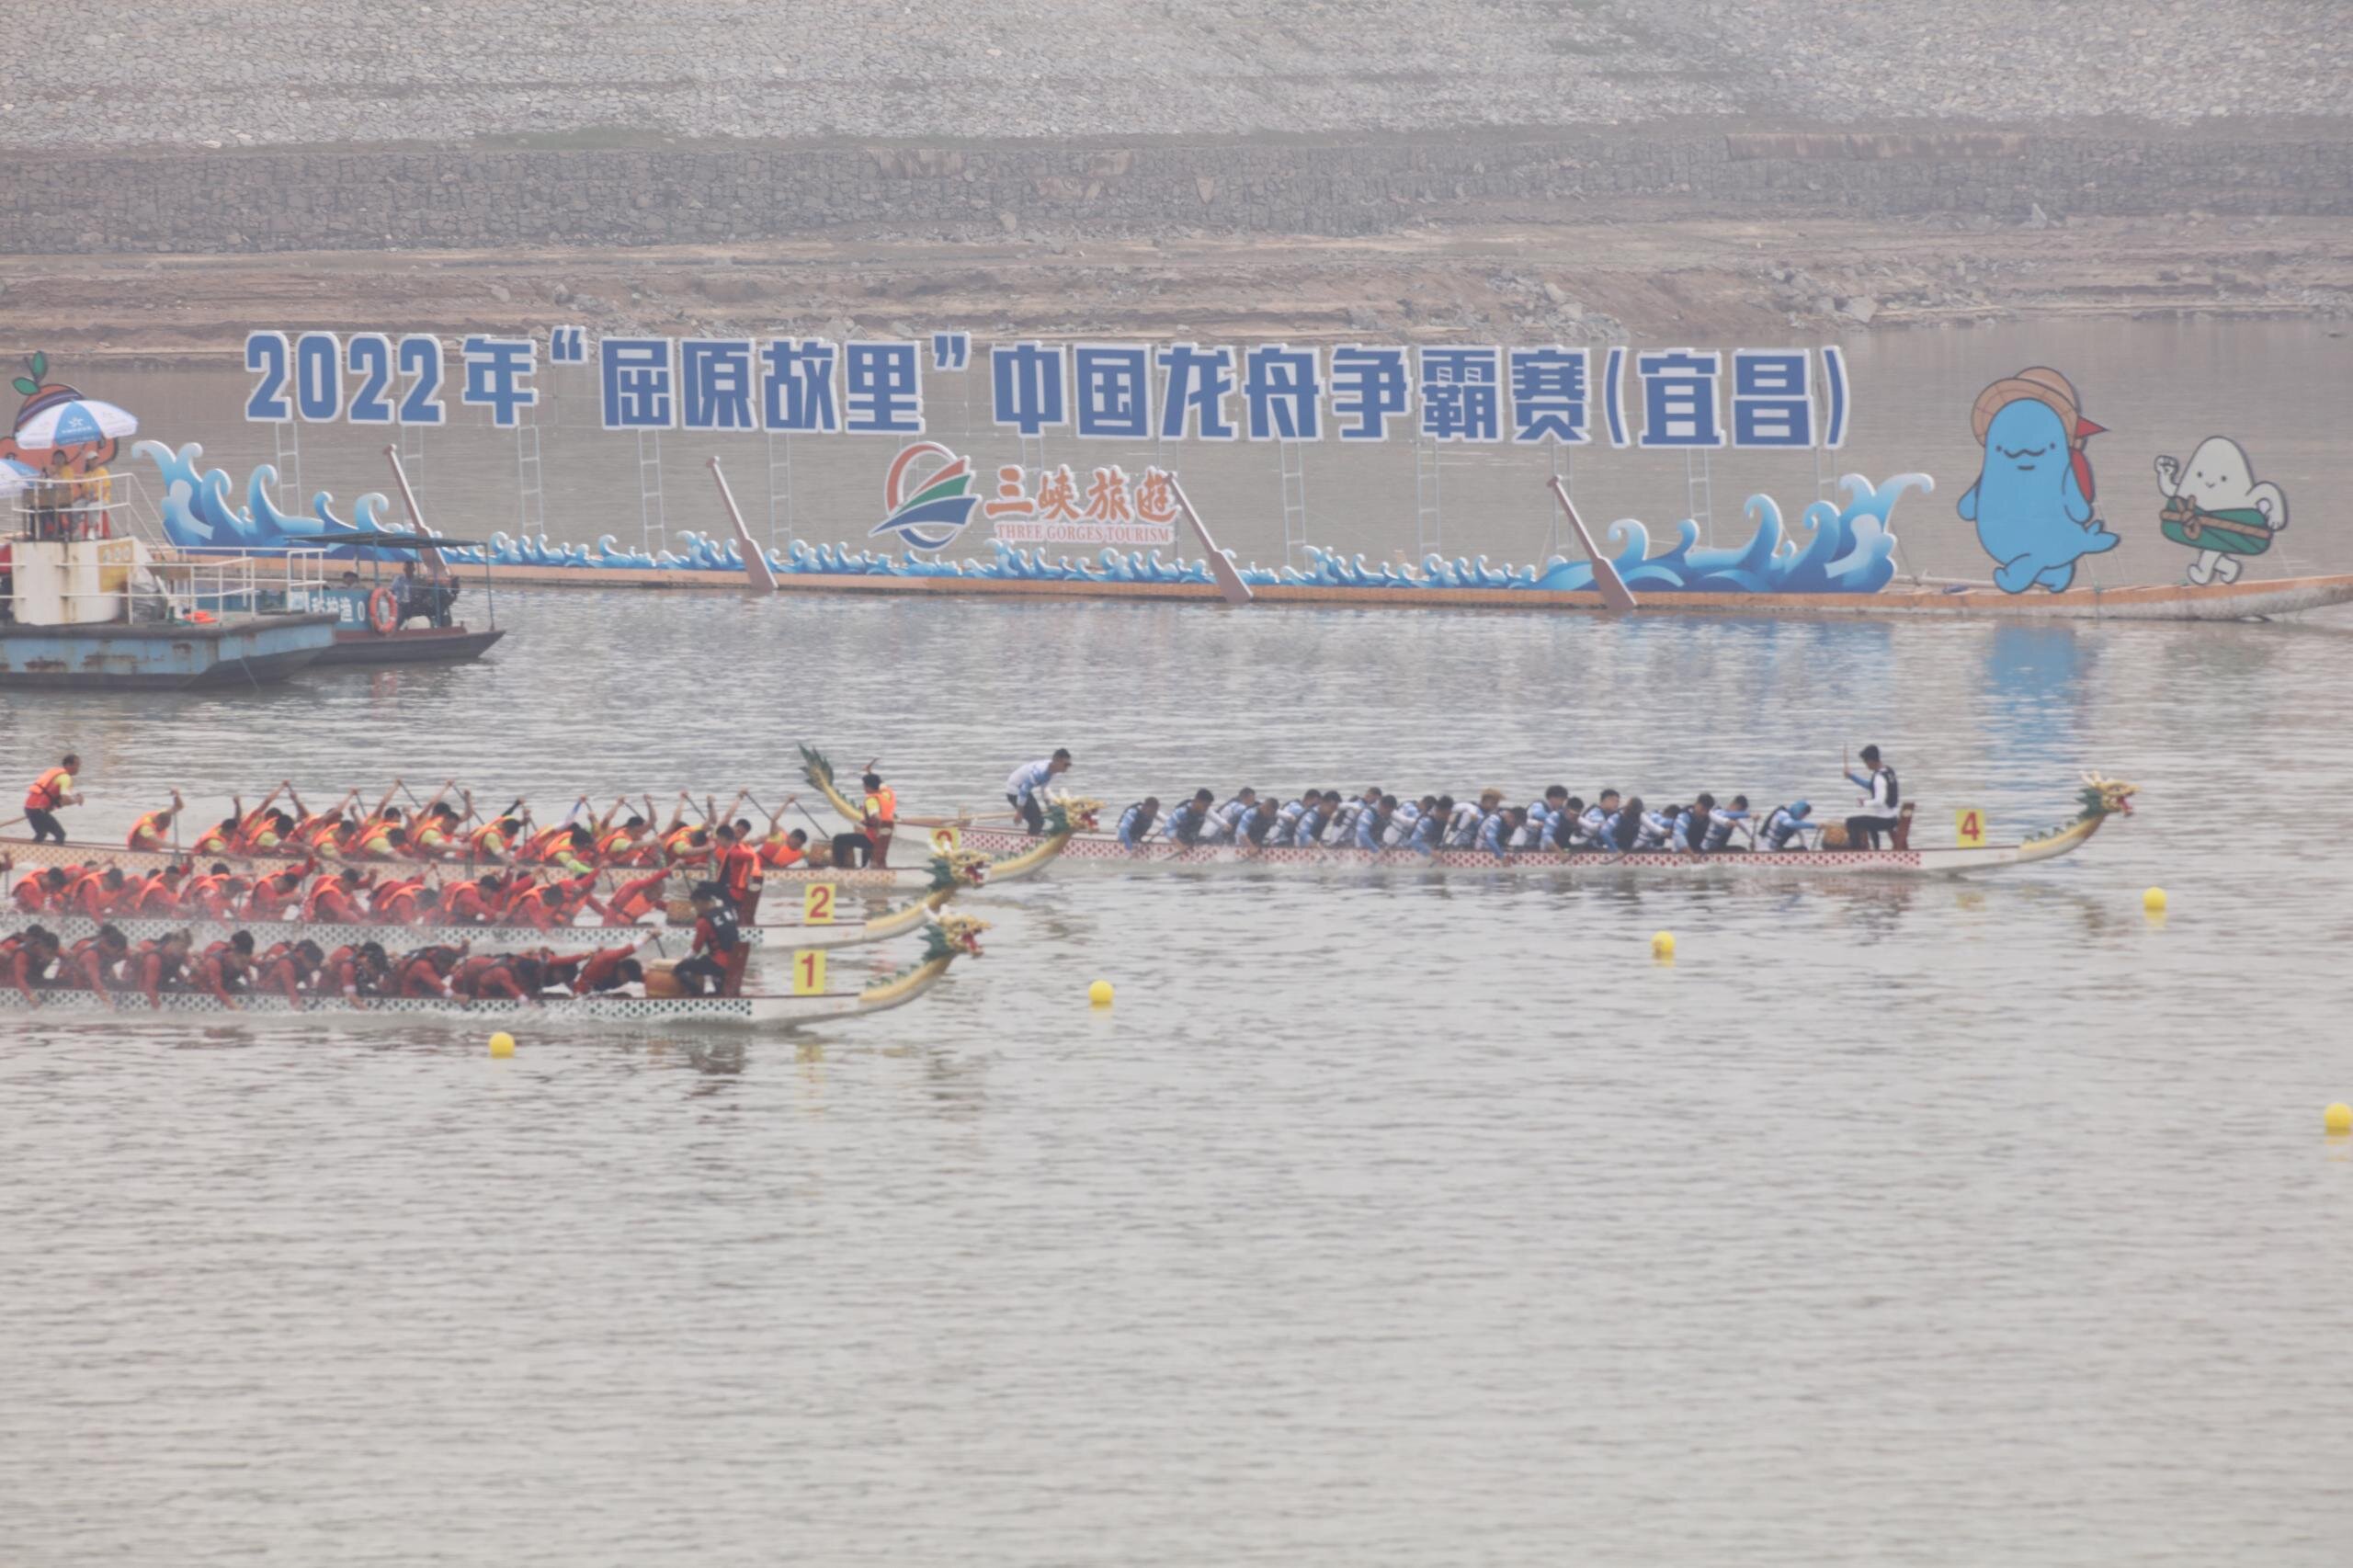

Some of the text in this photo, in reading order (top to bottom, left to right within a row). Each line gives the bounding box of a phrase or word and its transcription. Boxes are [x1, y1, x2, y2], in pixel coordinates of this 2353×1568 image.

[996, 524, 1169, 541] THREE GORGES TOURISM
[1961, 811, 1980, 841] 4
[809, 886, 830, 918] 2
[801, 952, 815, 988] 1
